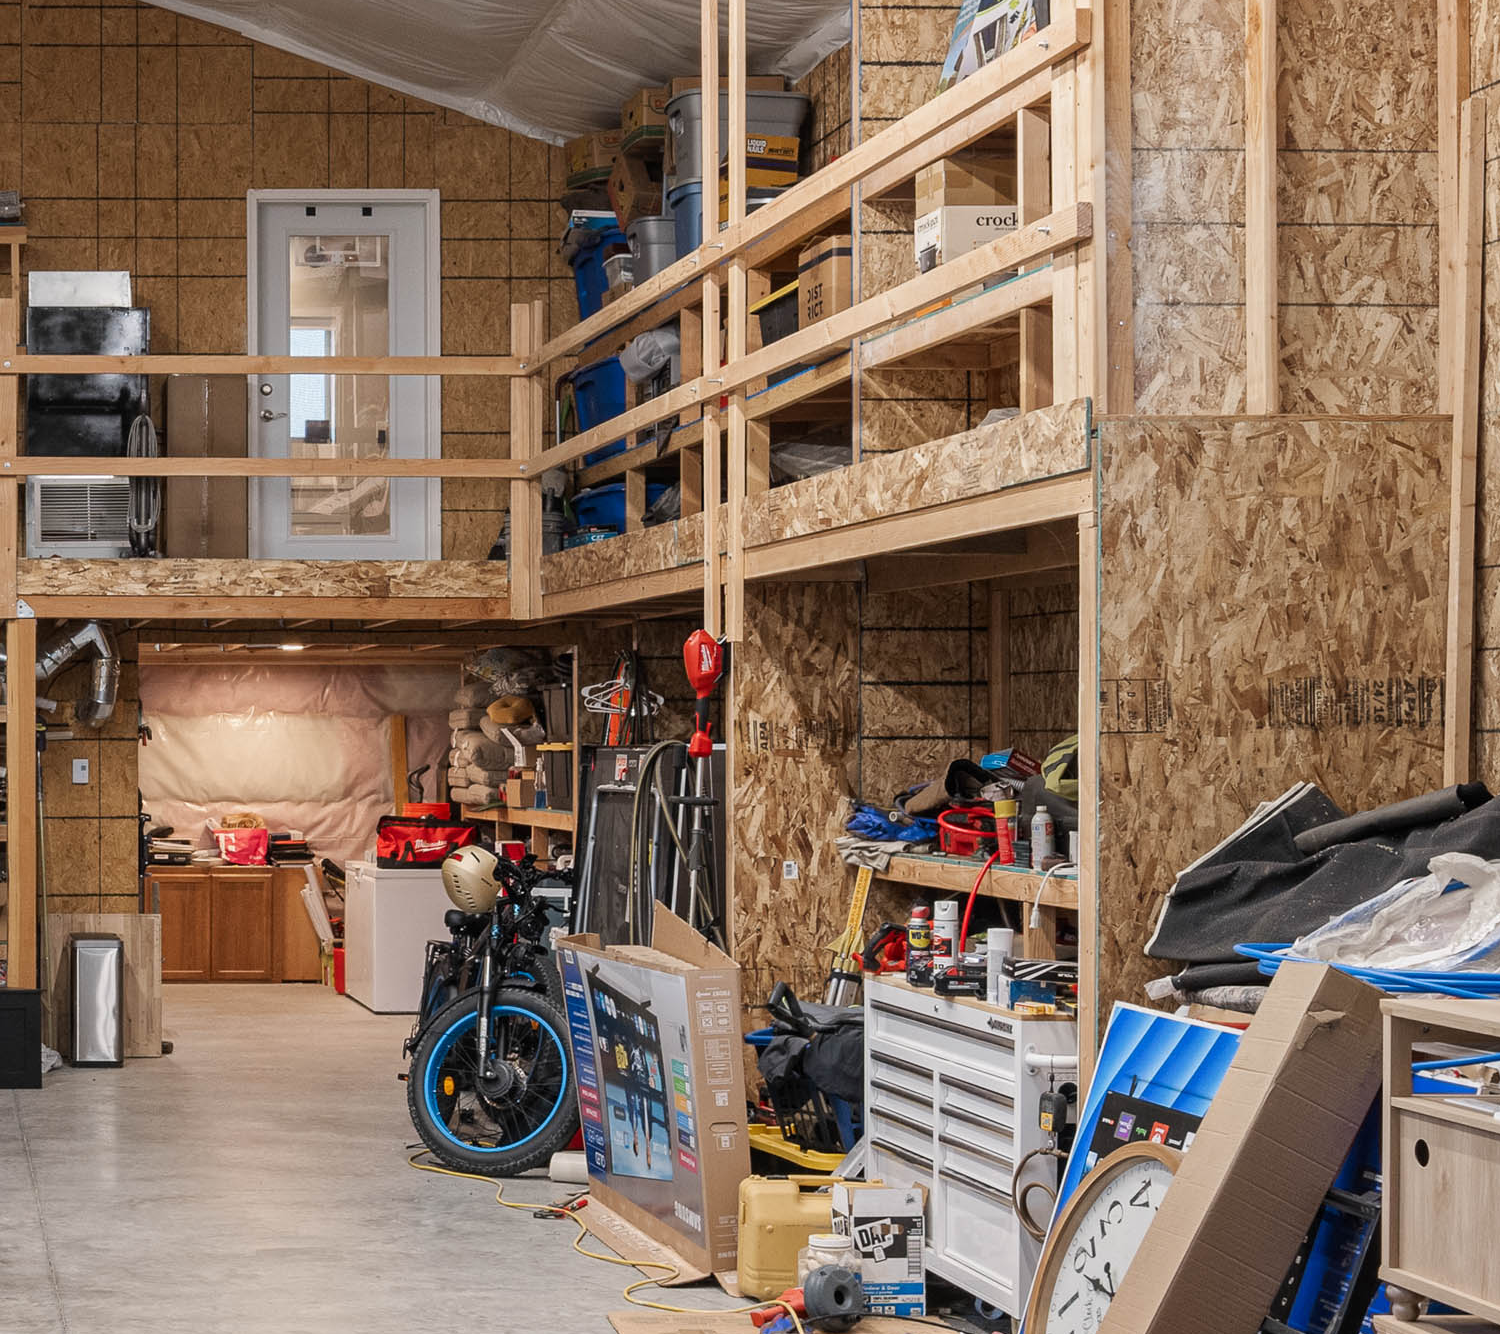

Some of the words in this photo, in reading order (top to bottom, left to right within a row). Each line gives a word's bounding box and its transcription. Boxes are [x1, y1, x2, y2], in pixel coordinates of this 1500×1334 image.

[747, 139, 767, 147] LIQUID
[747, 145, 764, 154] NAILS
[758, 721, 769, 751] APA
[414, 838, 448, 850] Milwaukee
